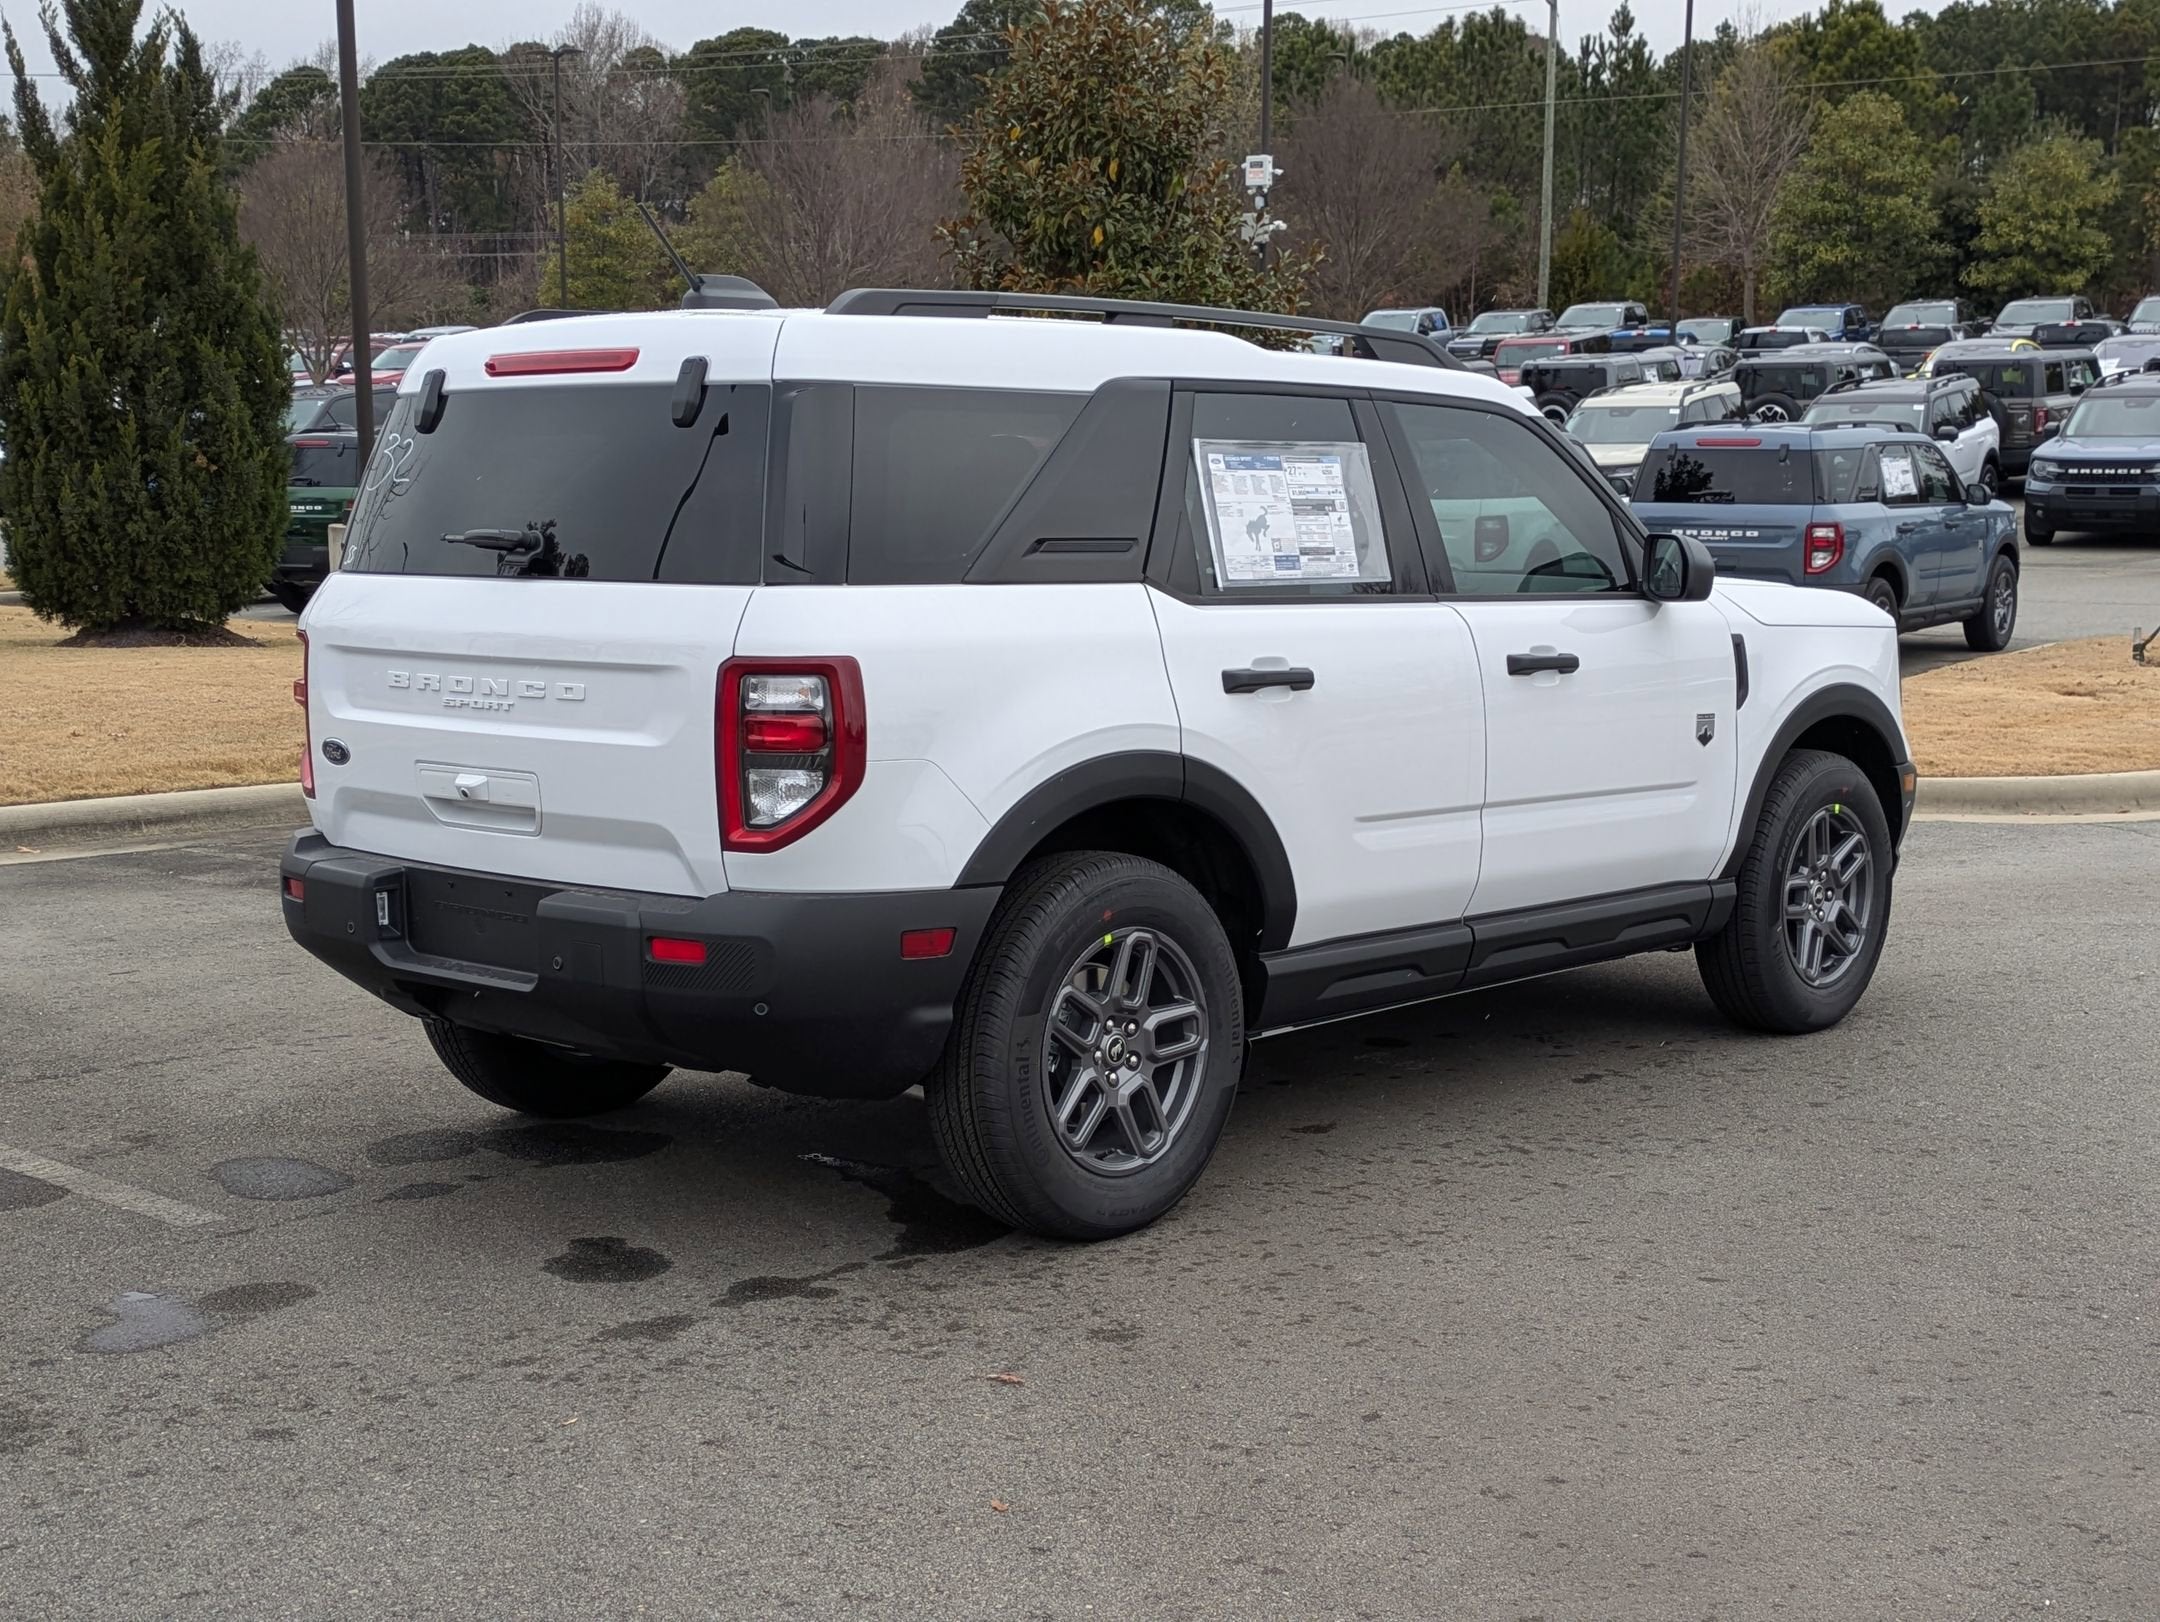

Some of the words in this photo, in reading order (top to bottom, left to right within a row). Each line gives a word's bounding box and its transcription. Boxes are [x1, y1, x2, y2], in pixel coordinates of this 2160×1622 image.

[366, 432, 414, 491] 32
[387, 669, 586, 701] BRONCO
[442, 697, 515, 711] SPORT
